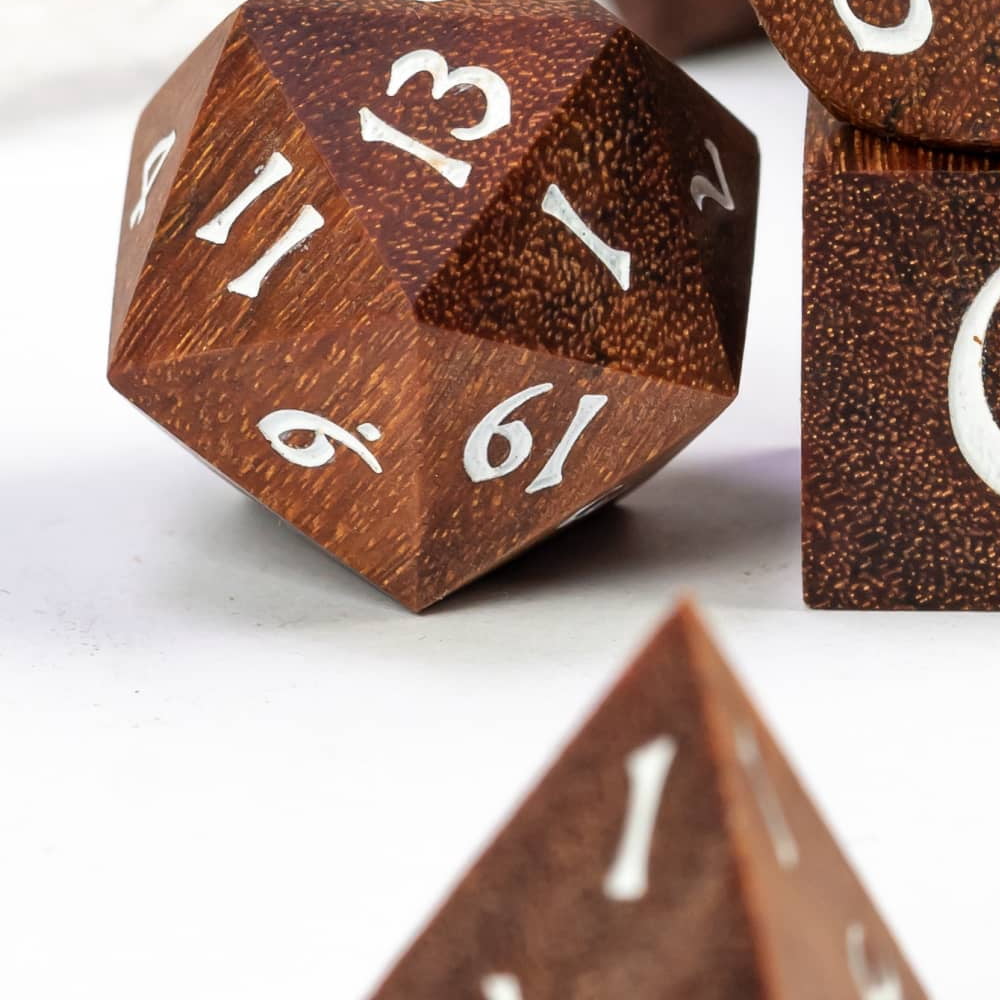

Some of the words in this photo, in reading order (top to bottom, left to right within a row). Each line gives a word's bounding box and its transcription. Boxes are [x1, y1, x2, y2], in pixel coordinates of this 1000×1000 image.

[358, 47, 513, 190] 13
[194, 150, 326, 299] 11
[540, 182, 633, 292] 1
[602, 733, 679, 903] 1
